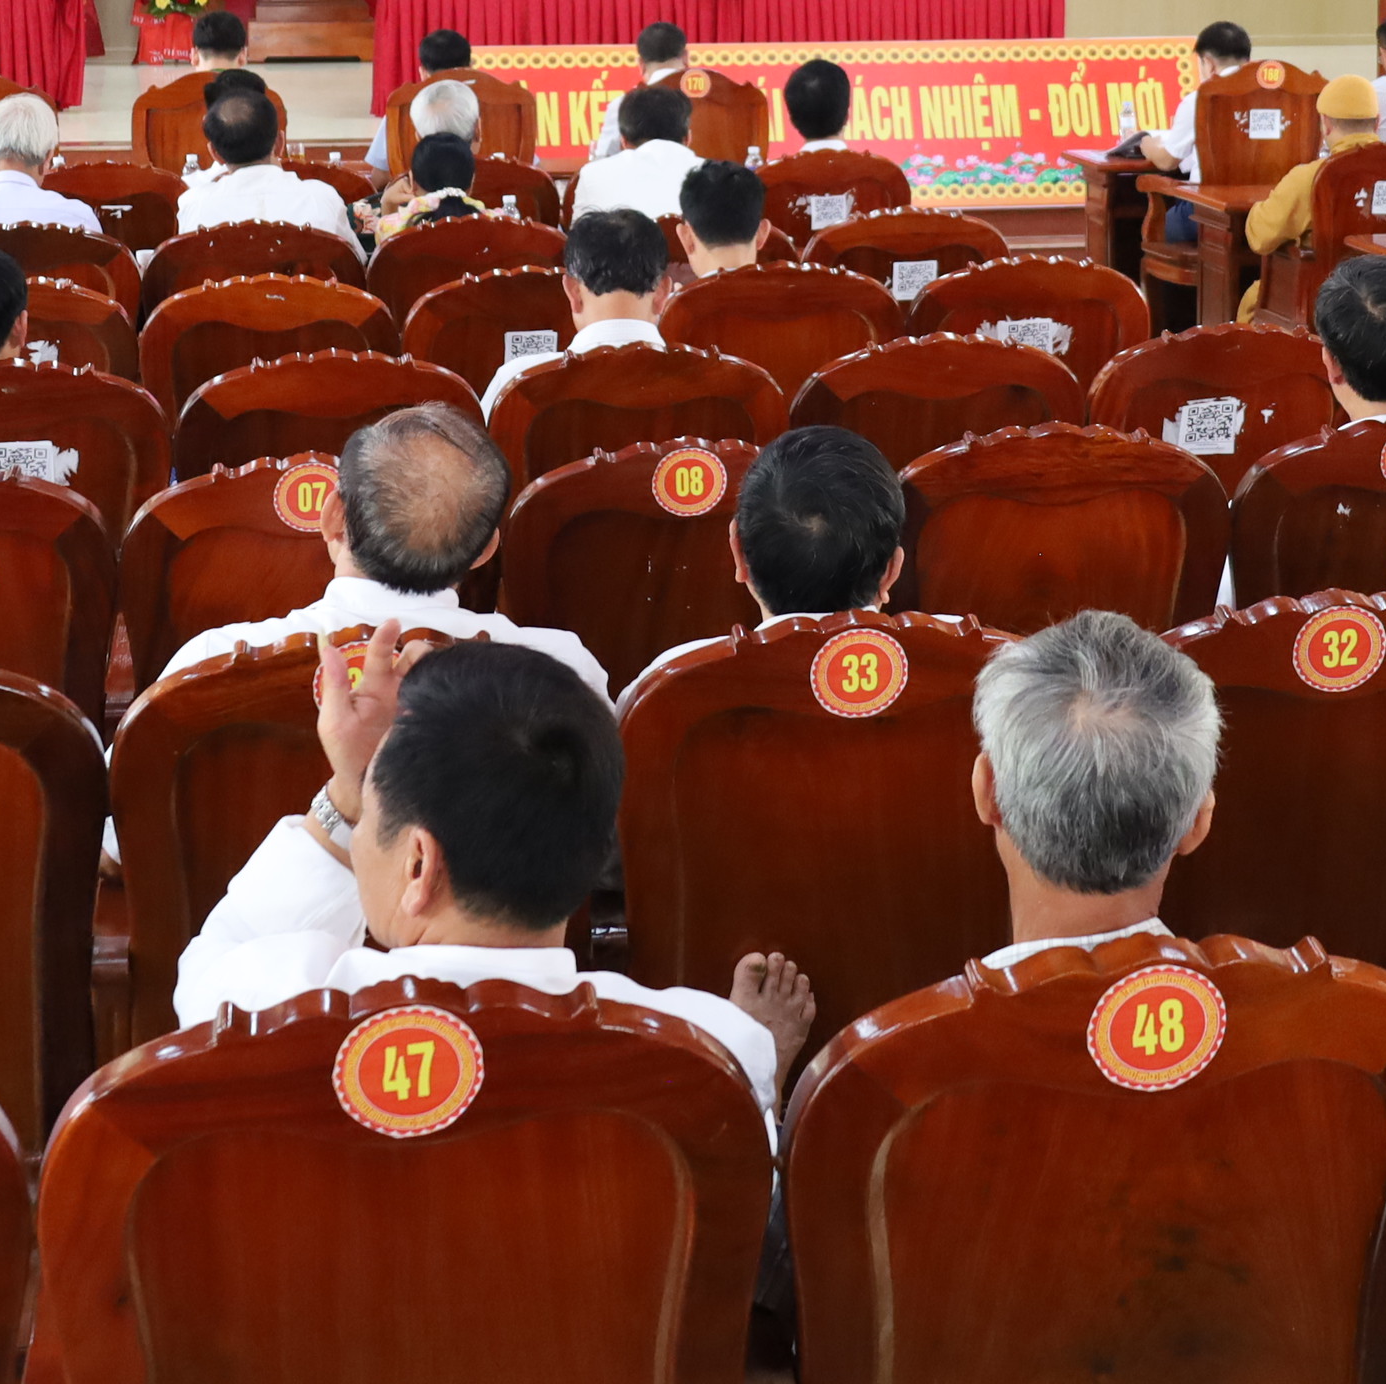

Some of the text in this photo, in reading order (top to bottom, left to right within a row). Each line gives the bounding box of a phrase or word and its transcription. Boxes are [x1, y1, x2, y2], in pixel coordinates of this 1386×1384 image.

[569, 71, 625, 146] KẾ
[919, 73, 1022, 151] NHIỆM
[1047, 62, 1101, 137] ĐỔI
[1106, 66, 1168, 137] MỚI
[297, 481, 326, 512] 07
[675, 466, 704, 497] 08
[1322, 628, 1358, 669] 32
[841, 652, 880, 694] 33
[1131, 997, 1186, 1056] 48
[382, 1041, 436, 1102] 47
